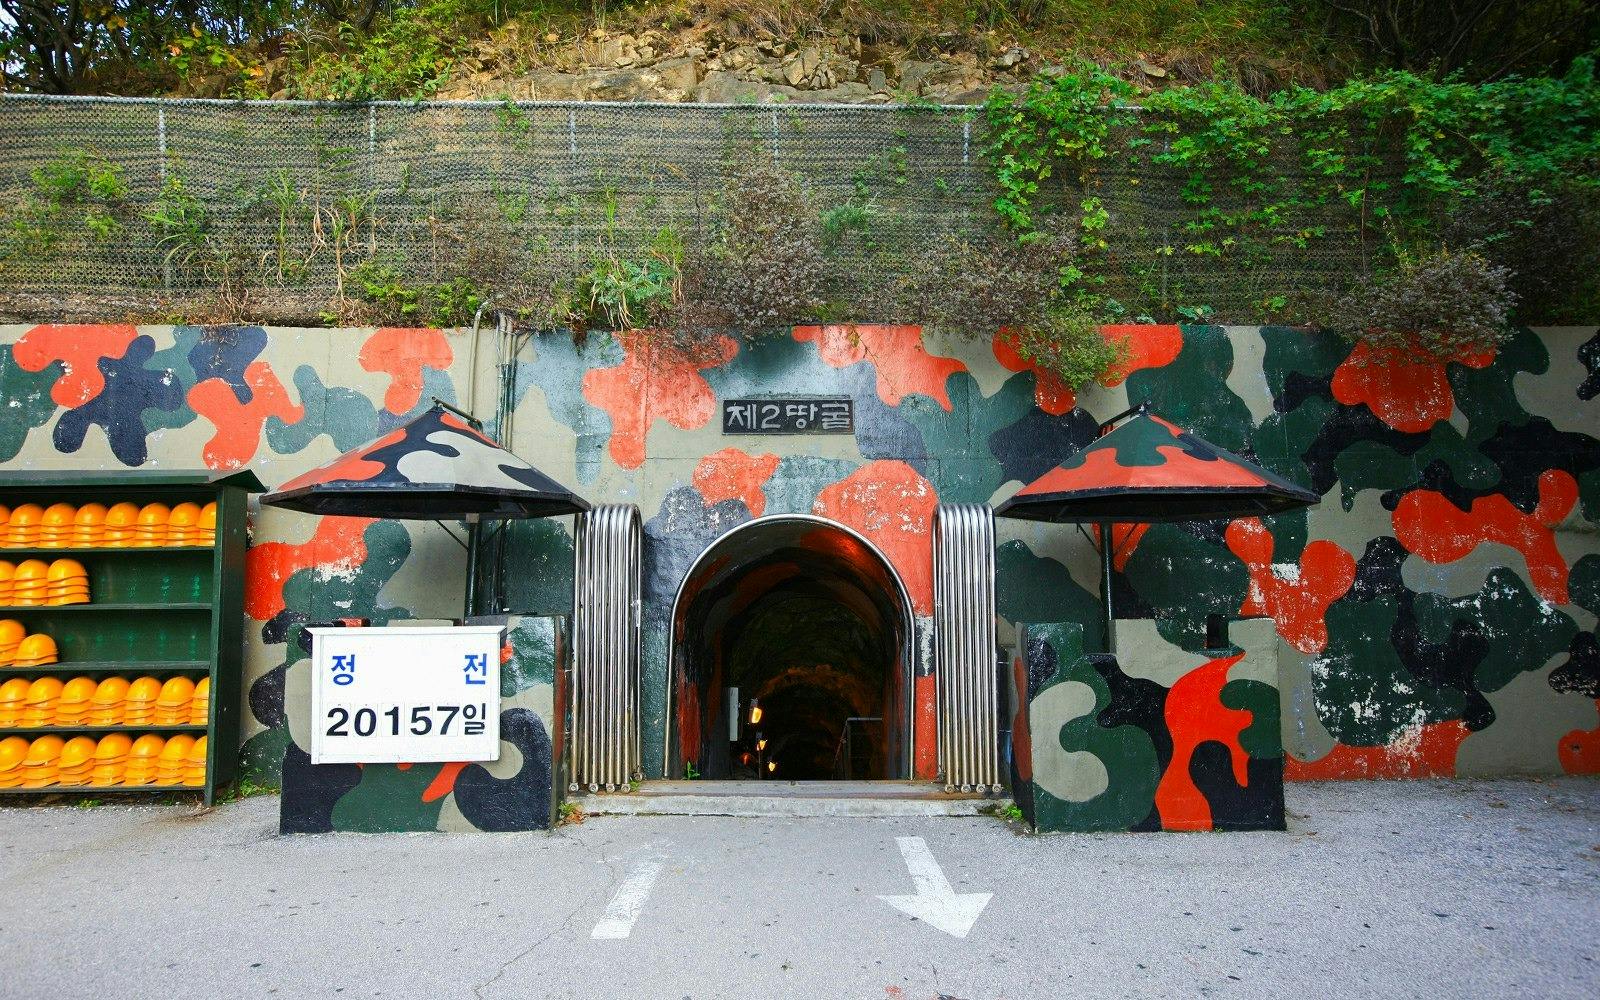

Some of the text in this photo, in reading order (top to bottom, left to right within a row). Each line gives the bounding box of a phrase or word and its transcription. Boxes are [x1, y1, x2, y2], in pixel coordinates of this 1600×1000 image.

[726, 402, 850, 430] 제2땅굴
[331, 653, 488, 686] 정 전
[326, 703, 486, 737] 20157일
